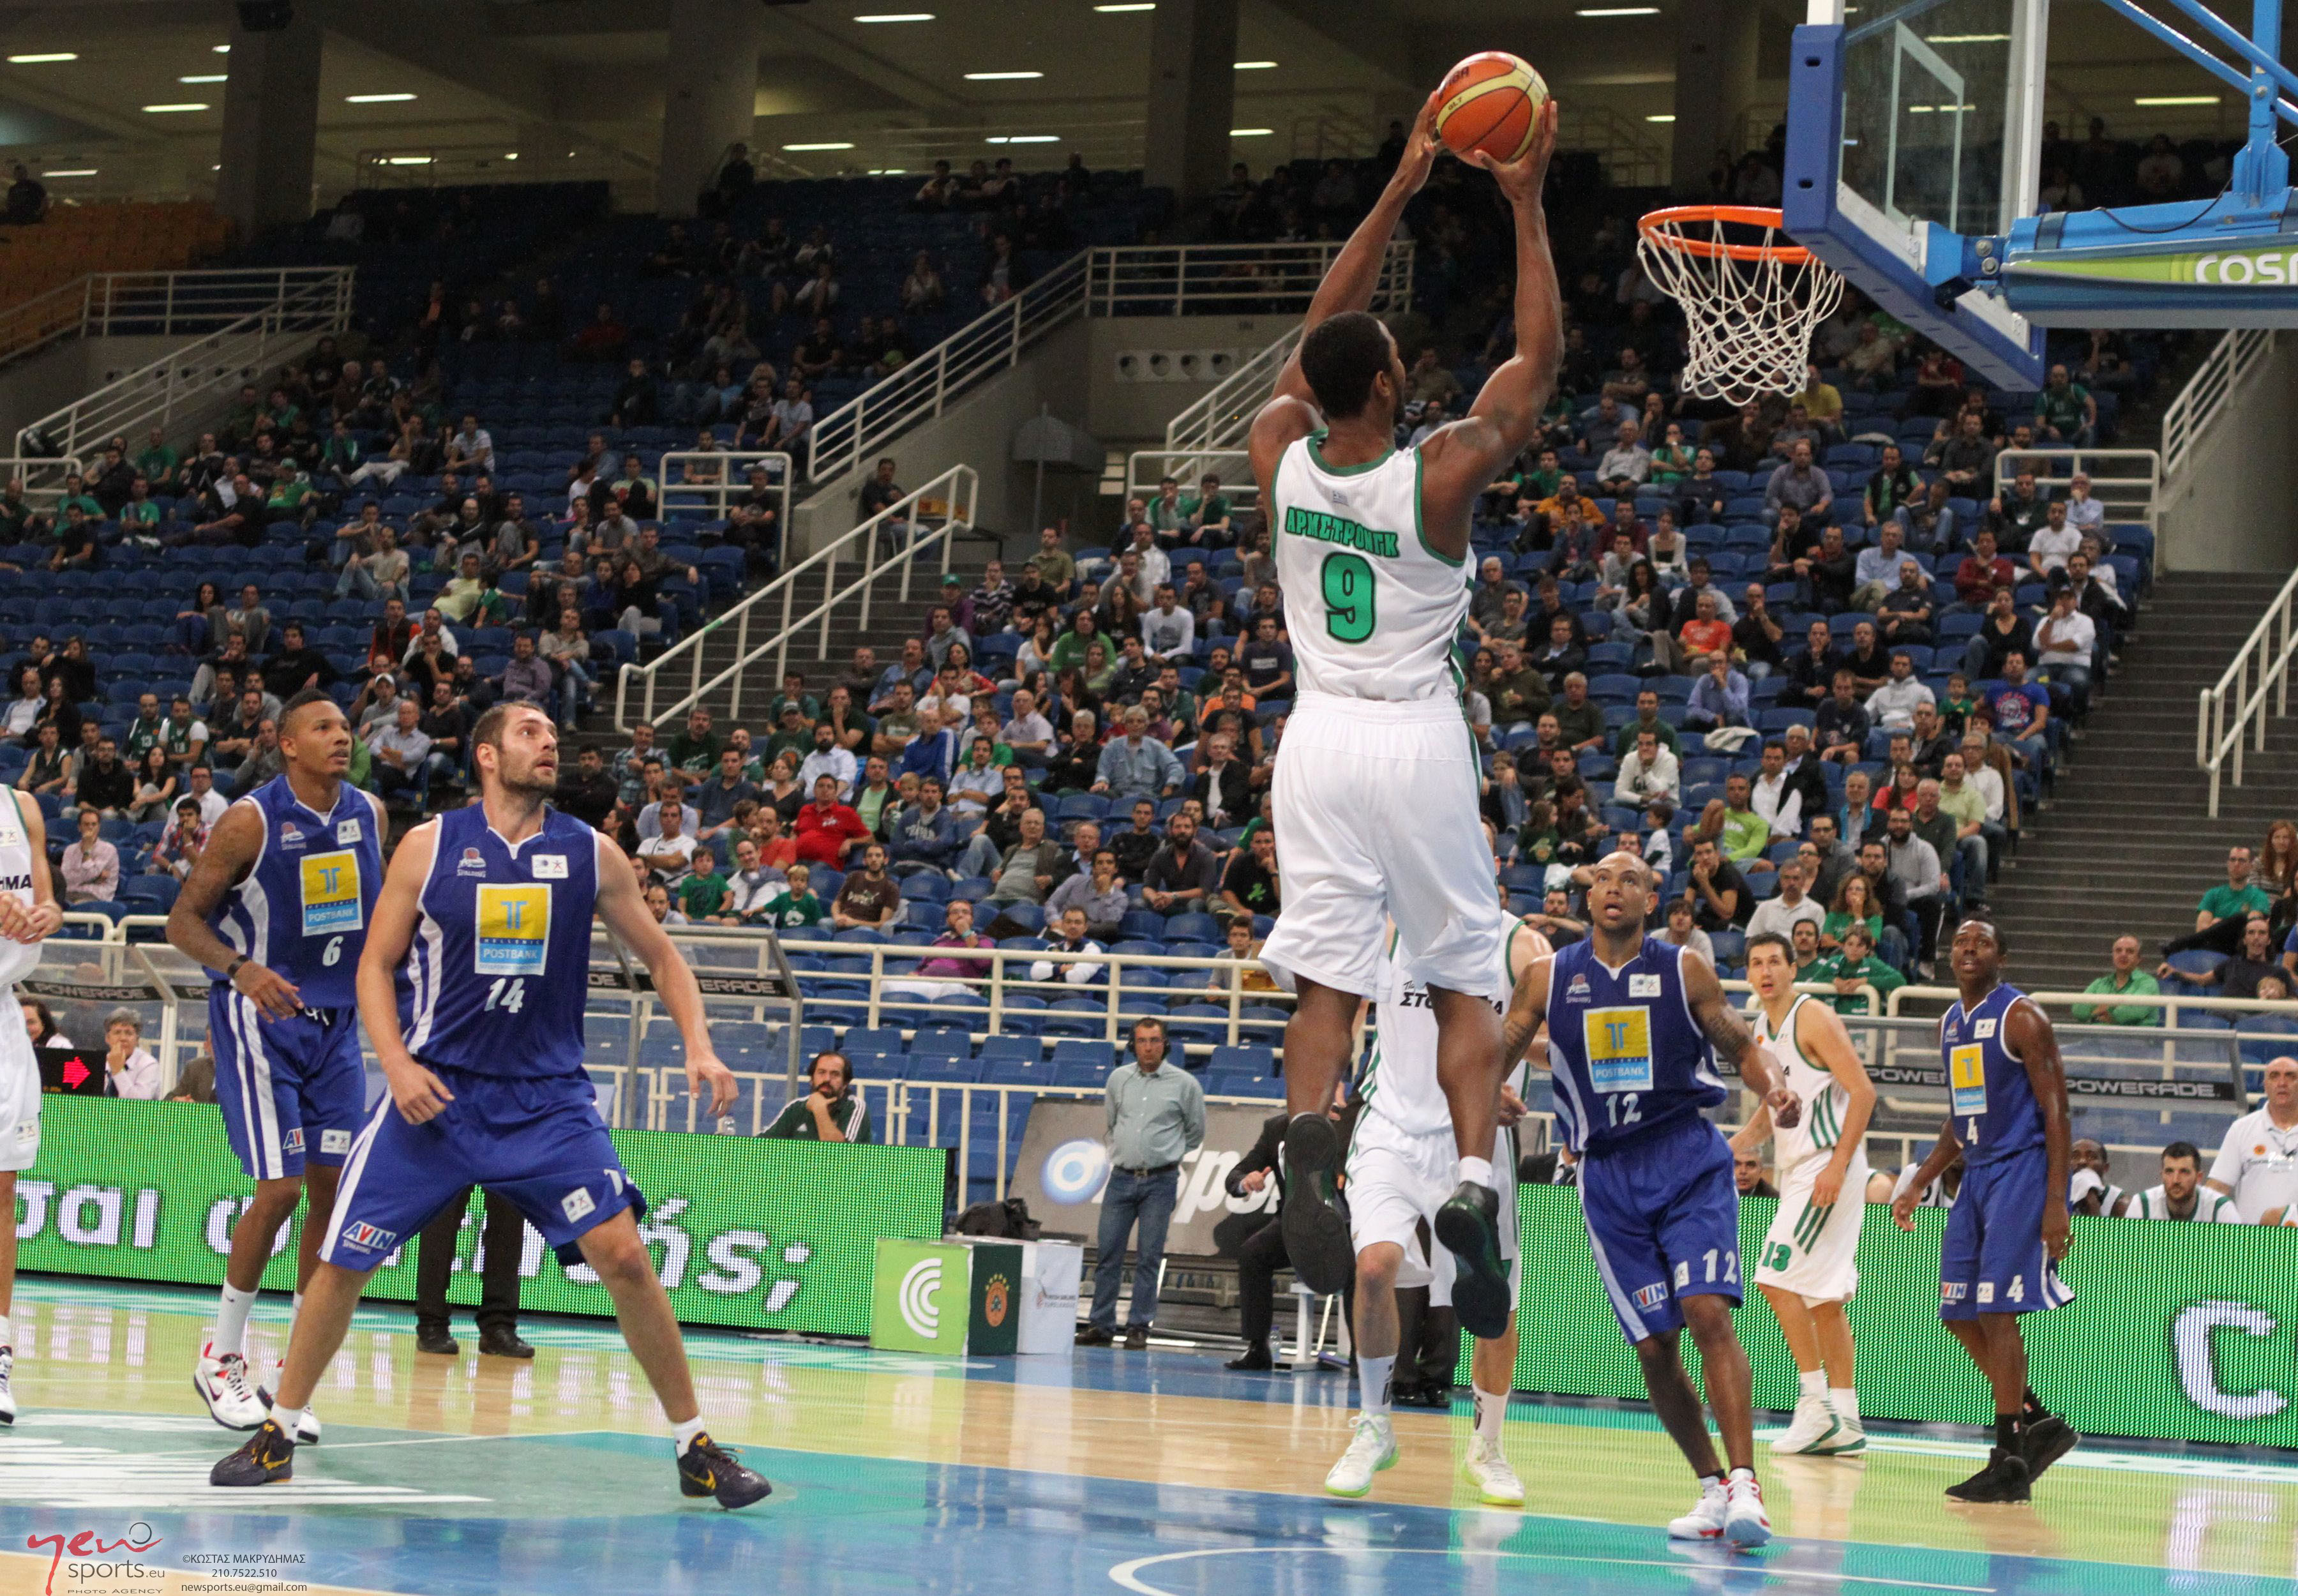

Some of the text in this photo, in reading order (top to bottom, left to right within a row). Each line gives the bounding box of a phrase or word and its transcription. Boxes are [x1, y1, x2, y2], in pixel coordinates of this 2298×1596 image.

[1321, 551, 1377, 645] 9
[308, 907, 355, 922] POSTBANK
[322, 935, 344, 967] 6
[483, 948, 537, 959] POSTBANK
[484, 977, 525, 1013] 14
[1595, 1066, 1645, 1078] POSTBANK
[1605, 1092, 1642, 1128] 12
[1967, 1117, 1979, 1145] 4
[344, 1222, 394, 1249] AVIN
[1702, 1249, 1738, 1284] 12
[1762, 1241, 1792, 1272] 13
[1941, 1283, 1966, 1299] VIN
[2006, 1274, 2024, 1303] 4
